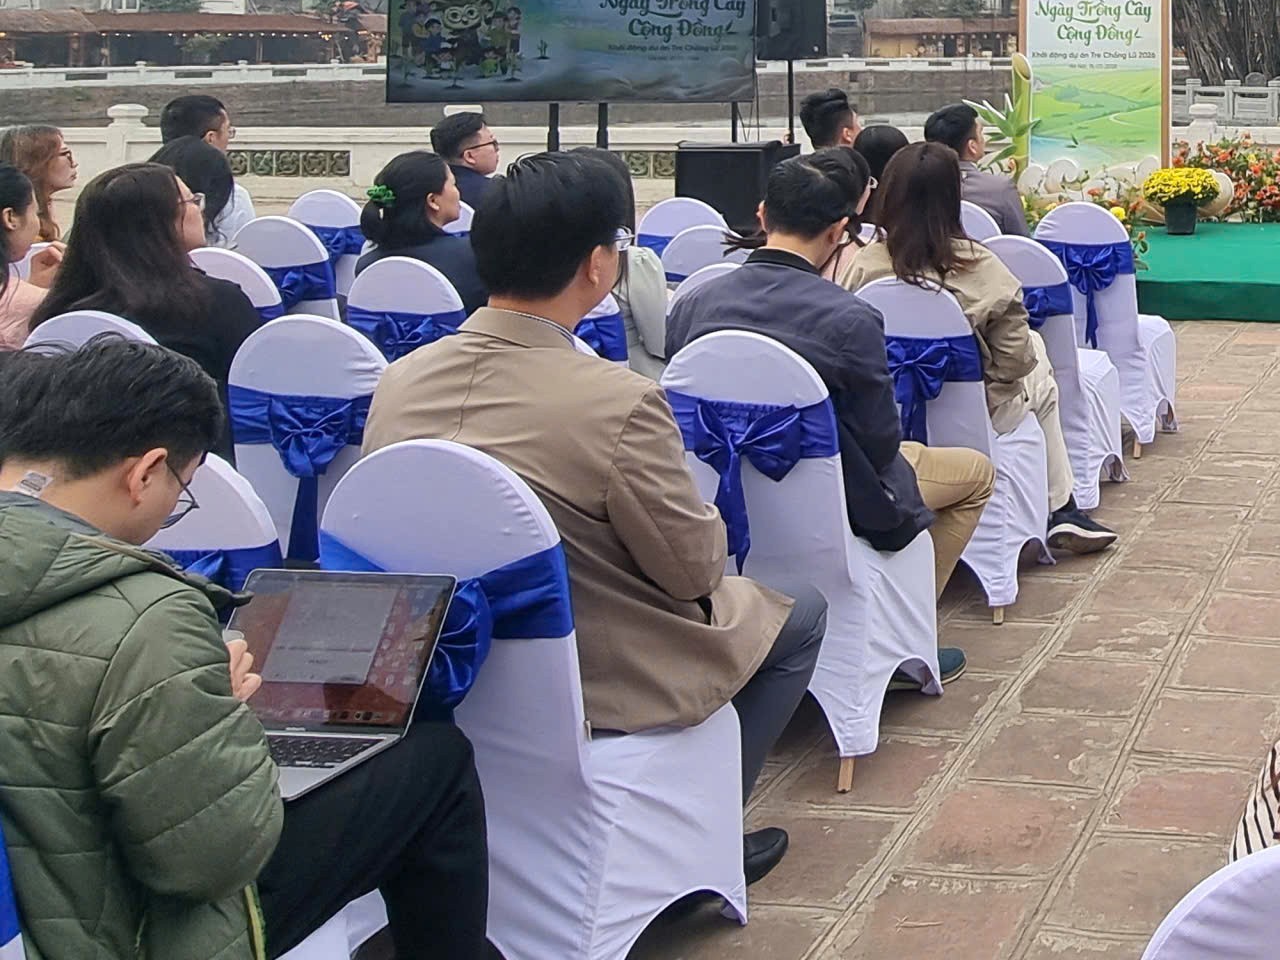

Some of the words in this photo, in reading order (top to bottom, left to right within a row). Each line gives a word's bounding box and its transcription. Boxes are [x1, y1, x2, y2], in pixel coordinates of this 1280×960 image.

[1035, 0, 1076, 23] Ngày
[1077, 0, 1121, 22] Trồng
[1124, 0, 1152, 23] Cây
[628, 18, 673, 44] Cộng
[677, 17, 725, 44] Đồng
[1057, 24, 1092, 46] Cộng
[1095, 23, 1133, 46] Đồng
